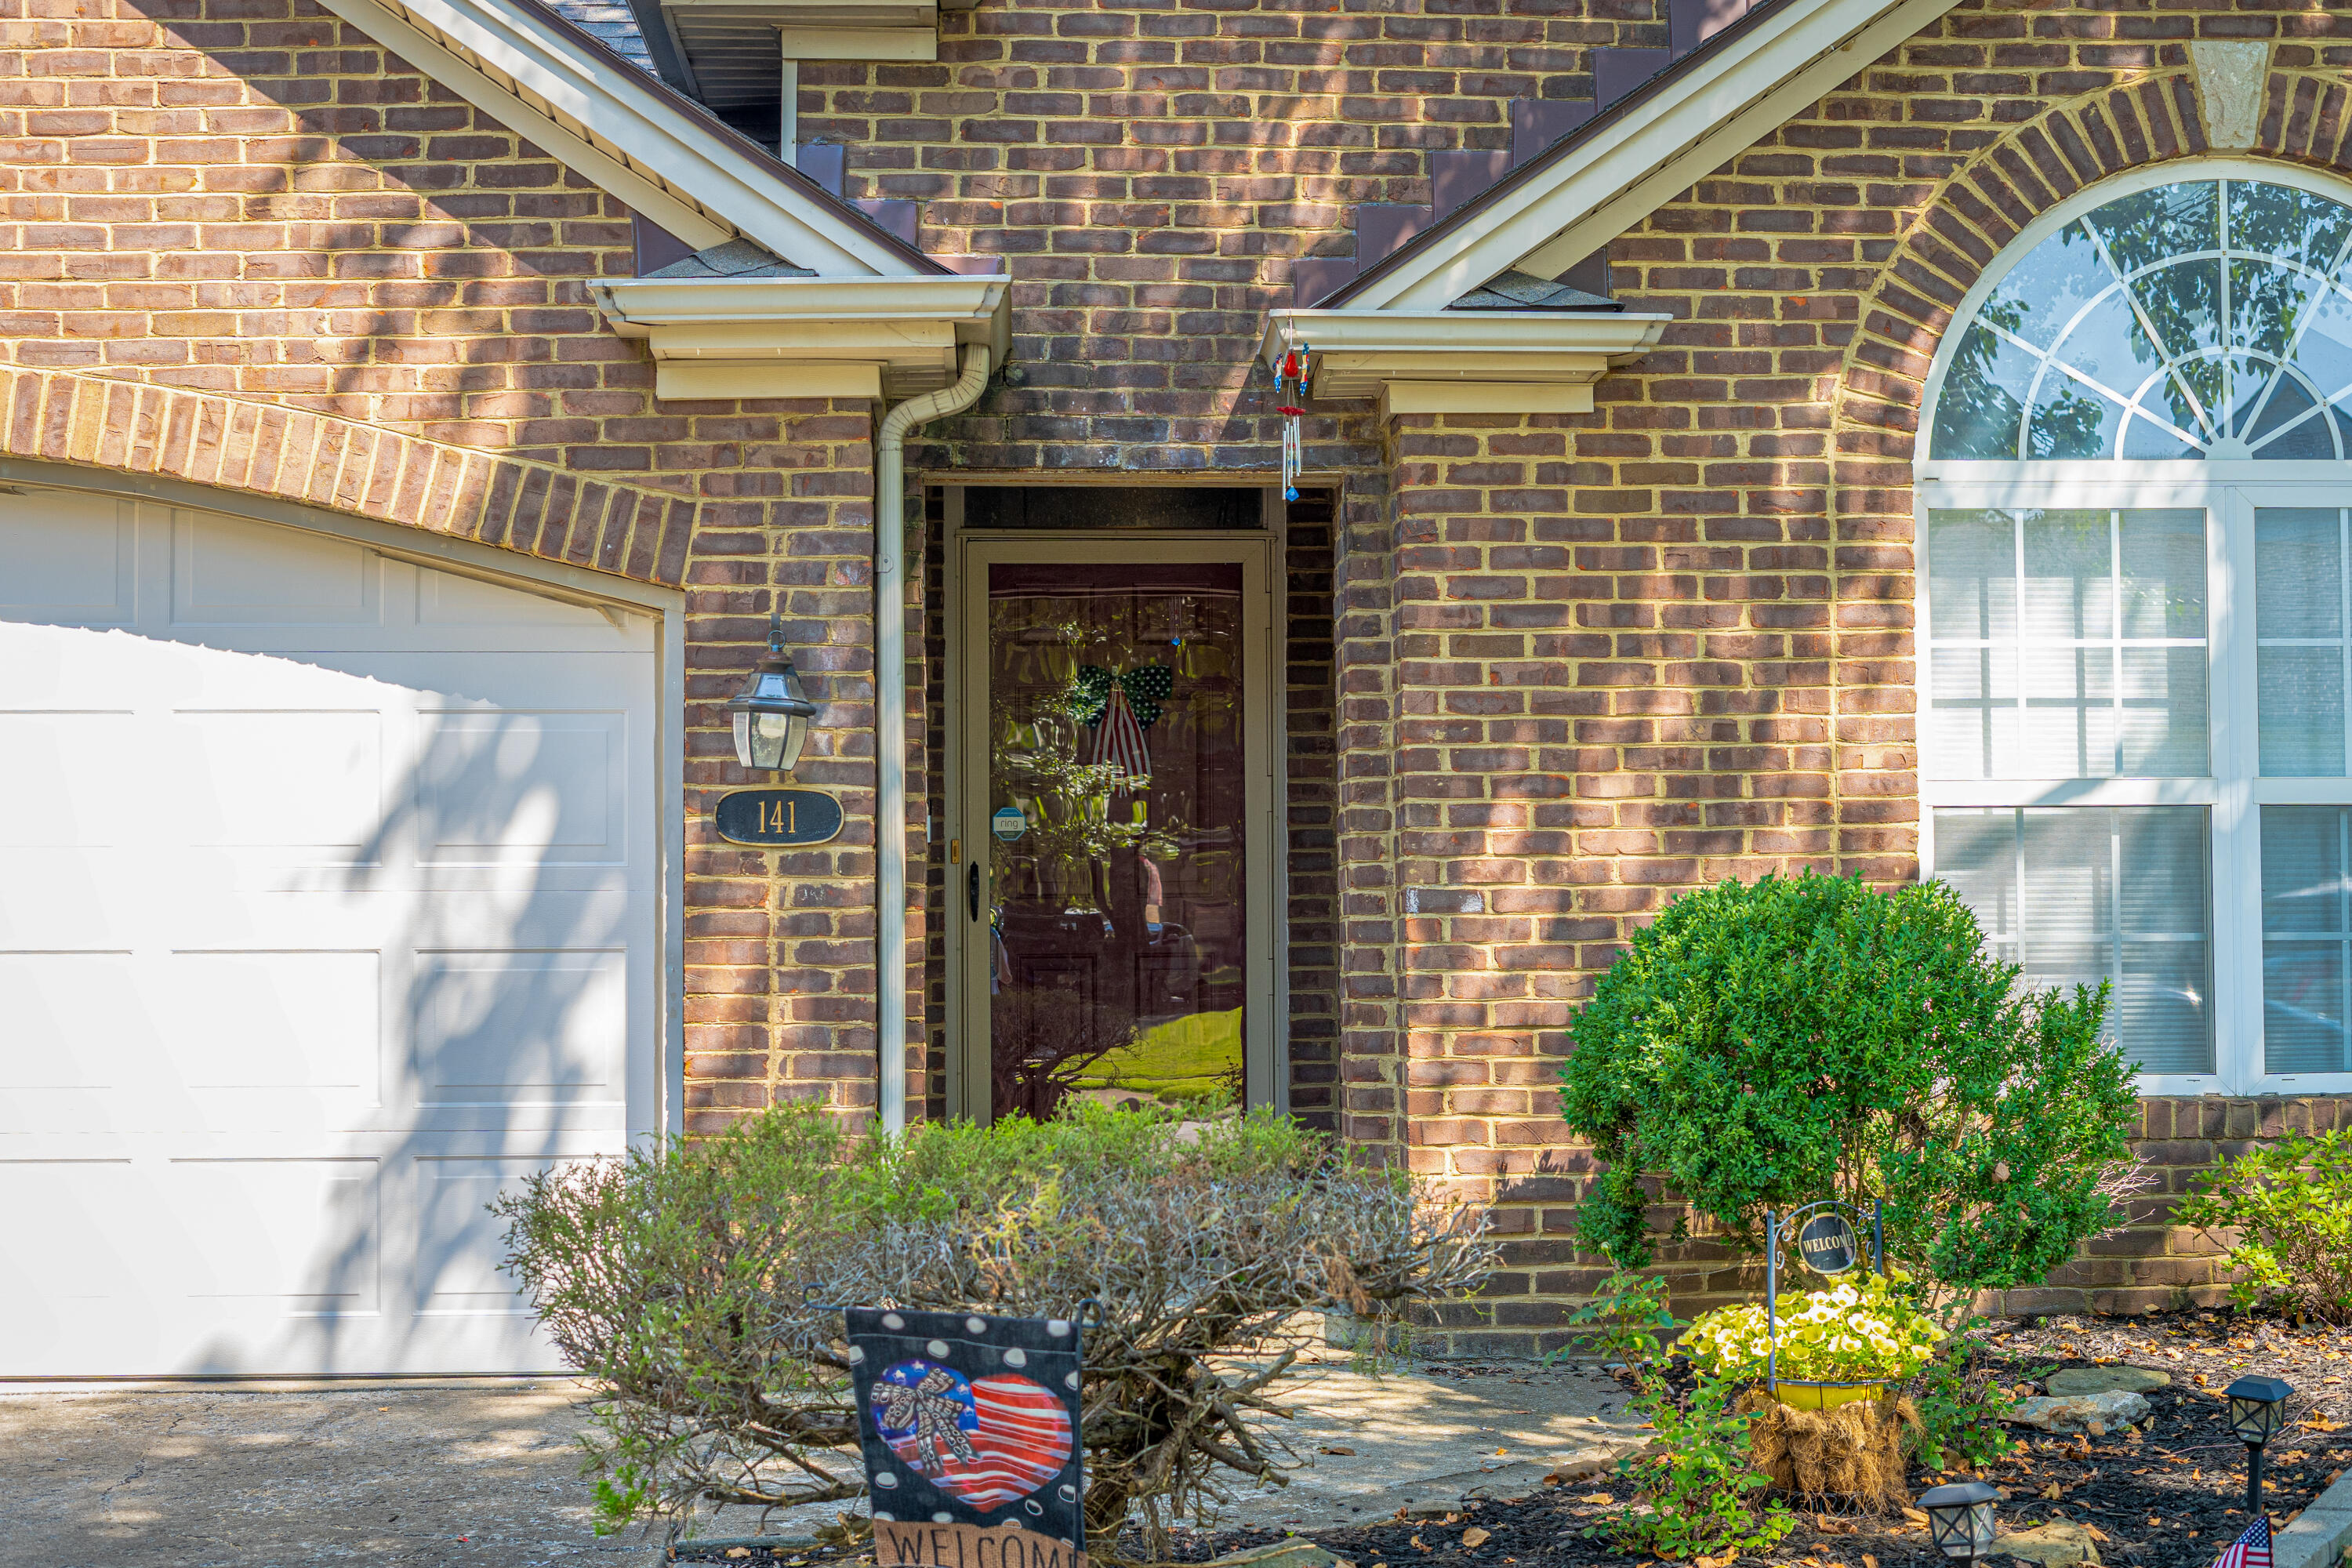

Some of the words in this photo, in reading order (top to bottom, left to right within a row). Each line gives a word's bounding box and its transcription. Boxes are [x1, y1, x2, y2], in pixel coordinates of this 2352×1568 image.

[758, 800, 796, 833] 141
[1000, 818, 1018, 829] ring
[1803, 1233, 1853, 1254] WELCOME
